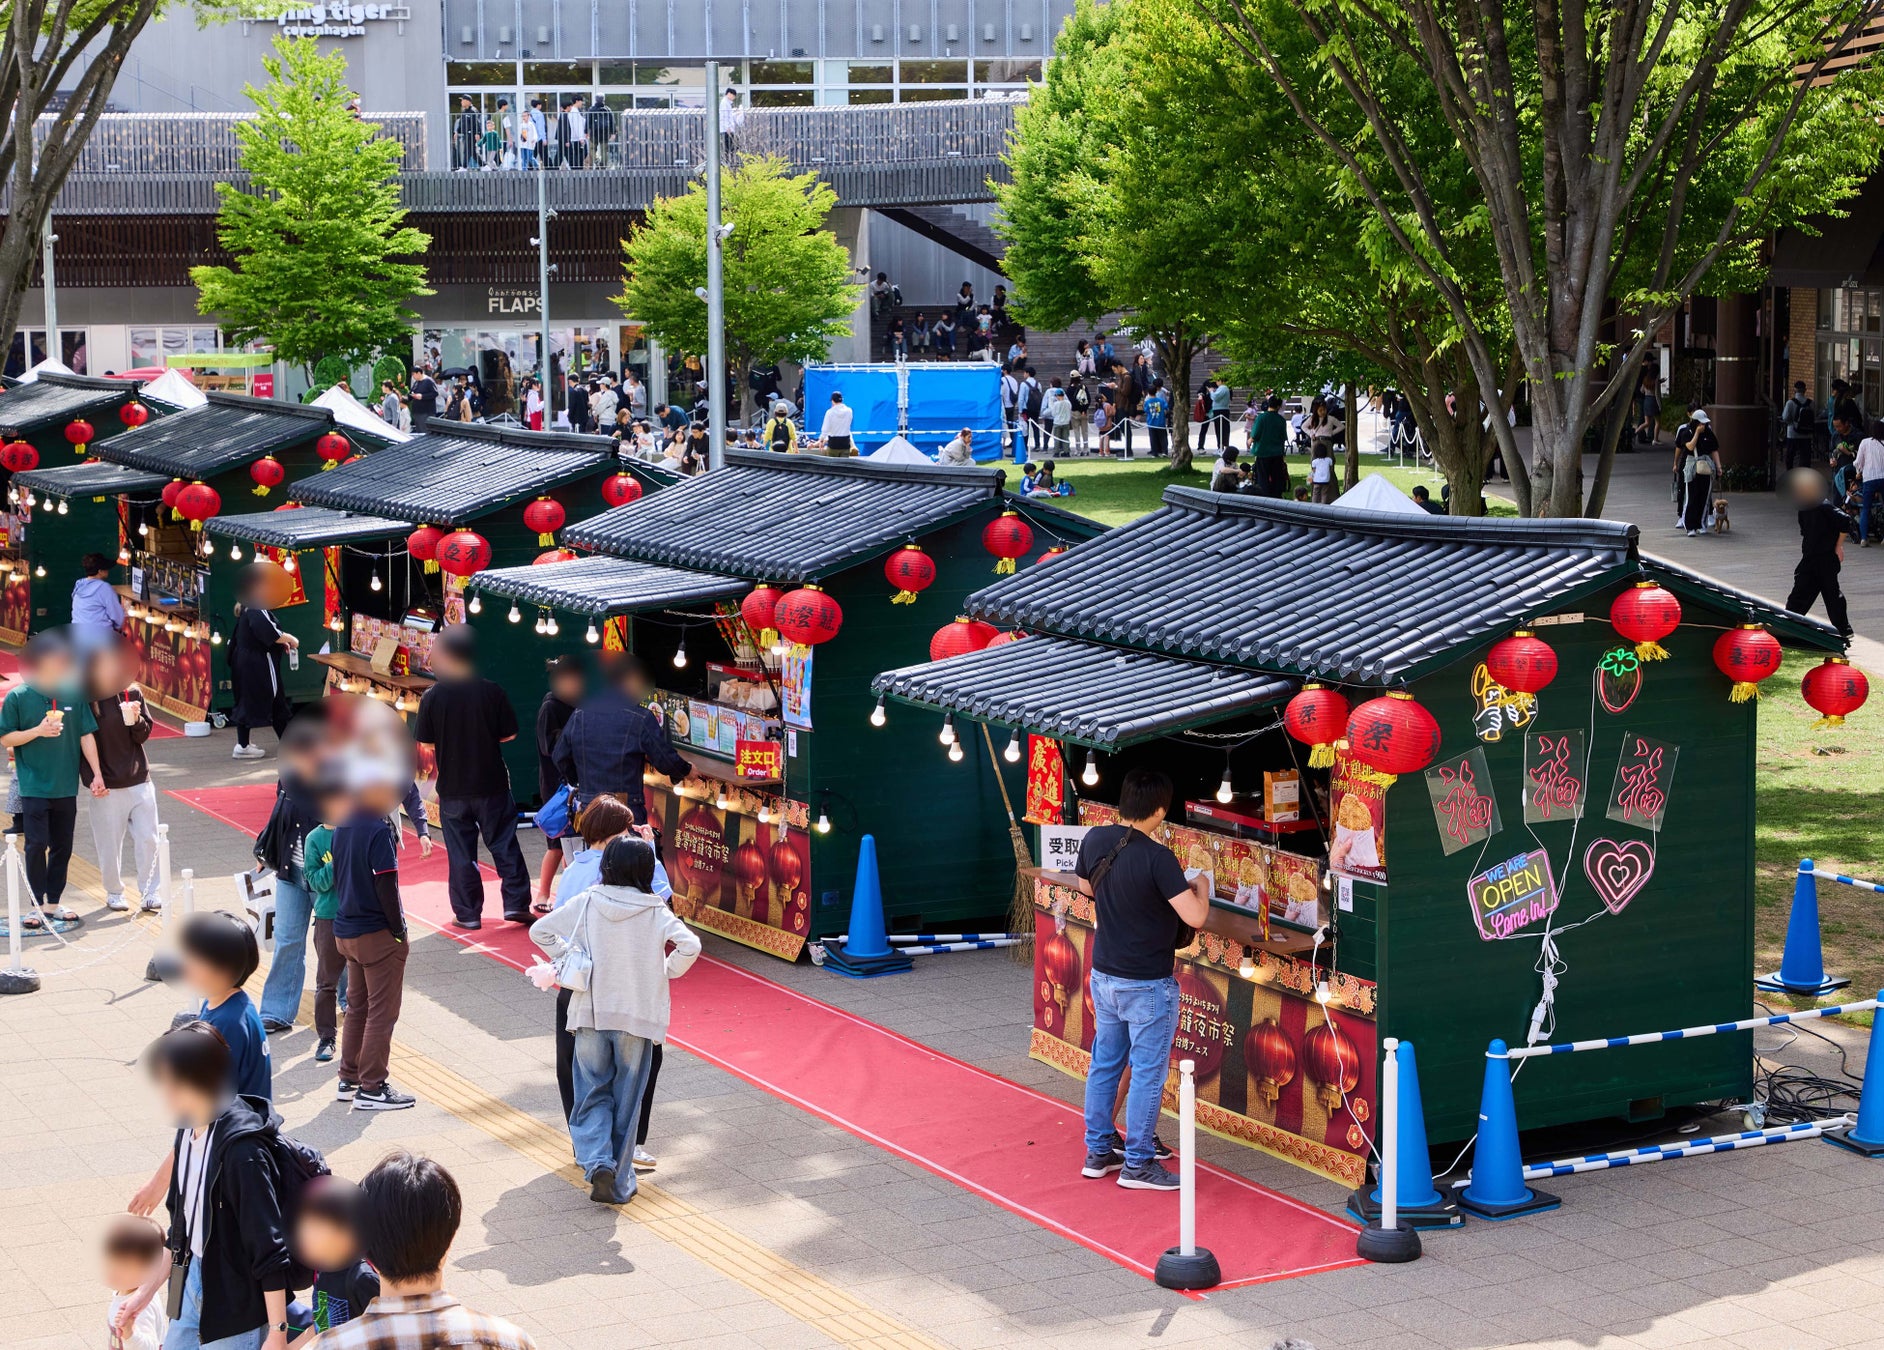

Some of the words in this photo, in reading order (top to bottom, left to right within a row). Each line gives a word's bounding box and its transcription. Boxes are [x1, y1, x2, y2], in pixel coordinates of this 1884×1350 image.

[328, 0, 392, 25] tiger
[282, 23, 366, 38] copenhagen
[740, 749, 776, 765] 注文口
[747, 767, 768, 777] Order
[1056, 858, 1074, 867] Pick
[1486, 866, 1506, 883] WE
[1508, 854, 1529, 873] ARE
[1483, 864, 1542, 909] OPEN
[1490, 907, 1529, 938] Come
[1175, 1035, 1208, 1057] 台湾フェス
